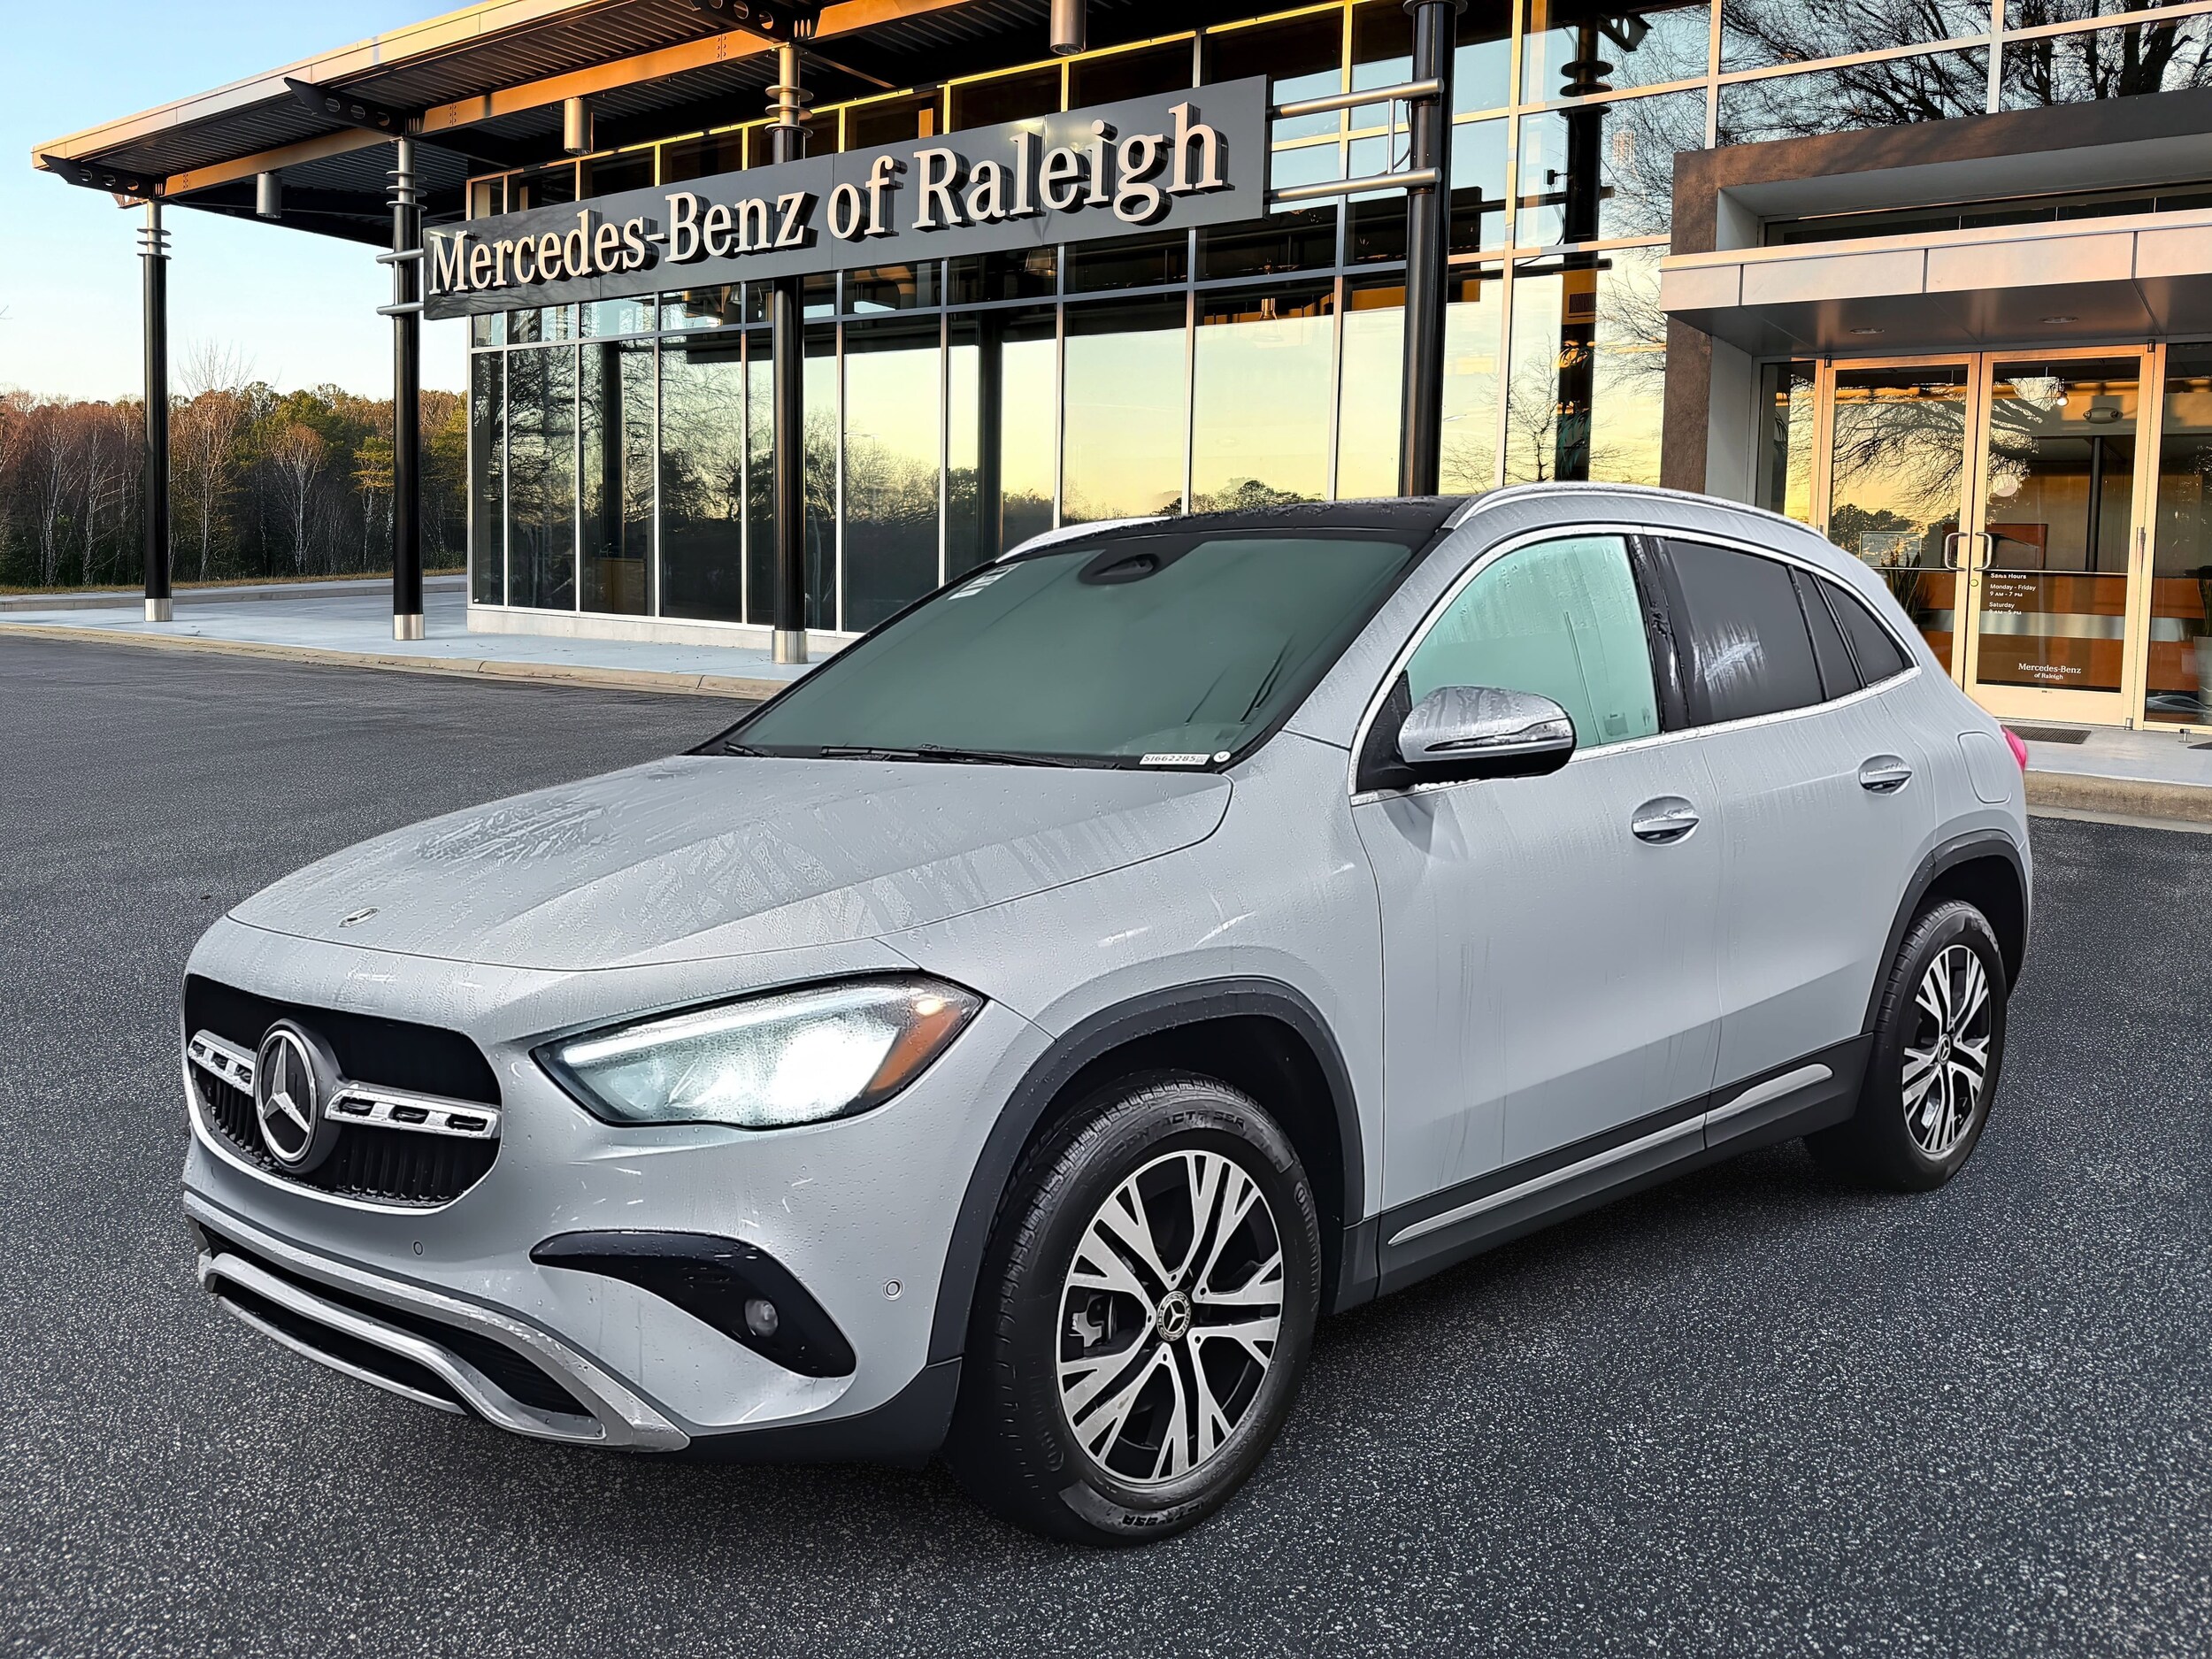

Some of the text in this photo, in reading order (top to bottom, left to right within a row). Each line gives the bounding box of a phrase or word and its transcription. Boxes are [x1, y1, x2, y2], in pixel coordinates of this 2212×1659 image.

[428, 101, 1228, 296] Mercedes-Benz of Raleigh
[2018, 663, 2081, 673] Mercedes-Benz
